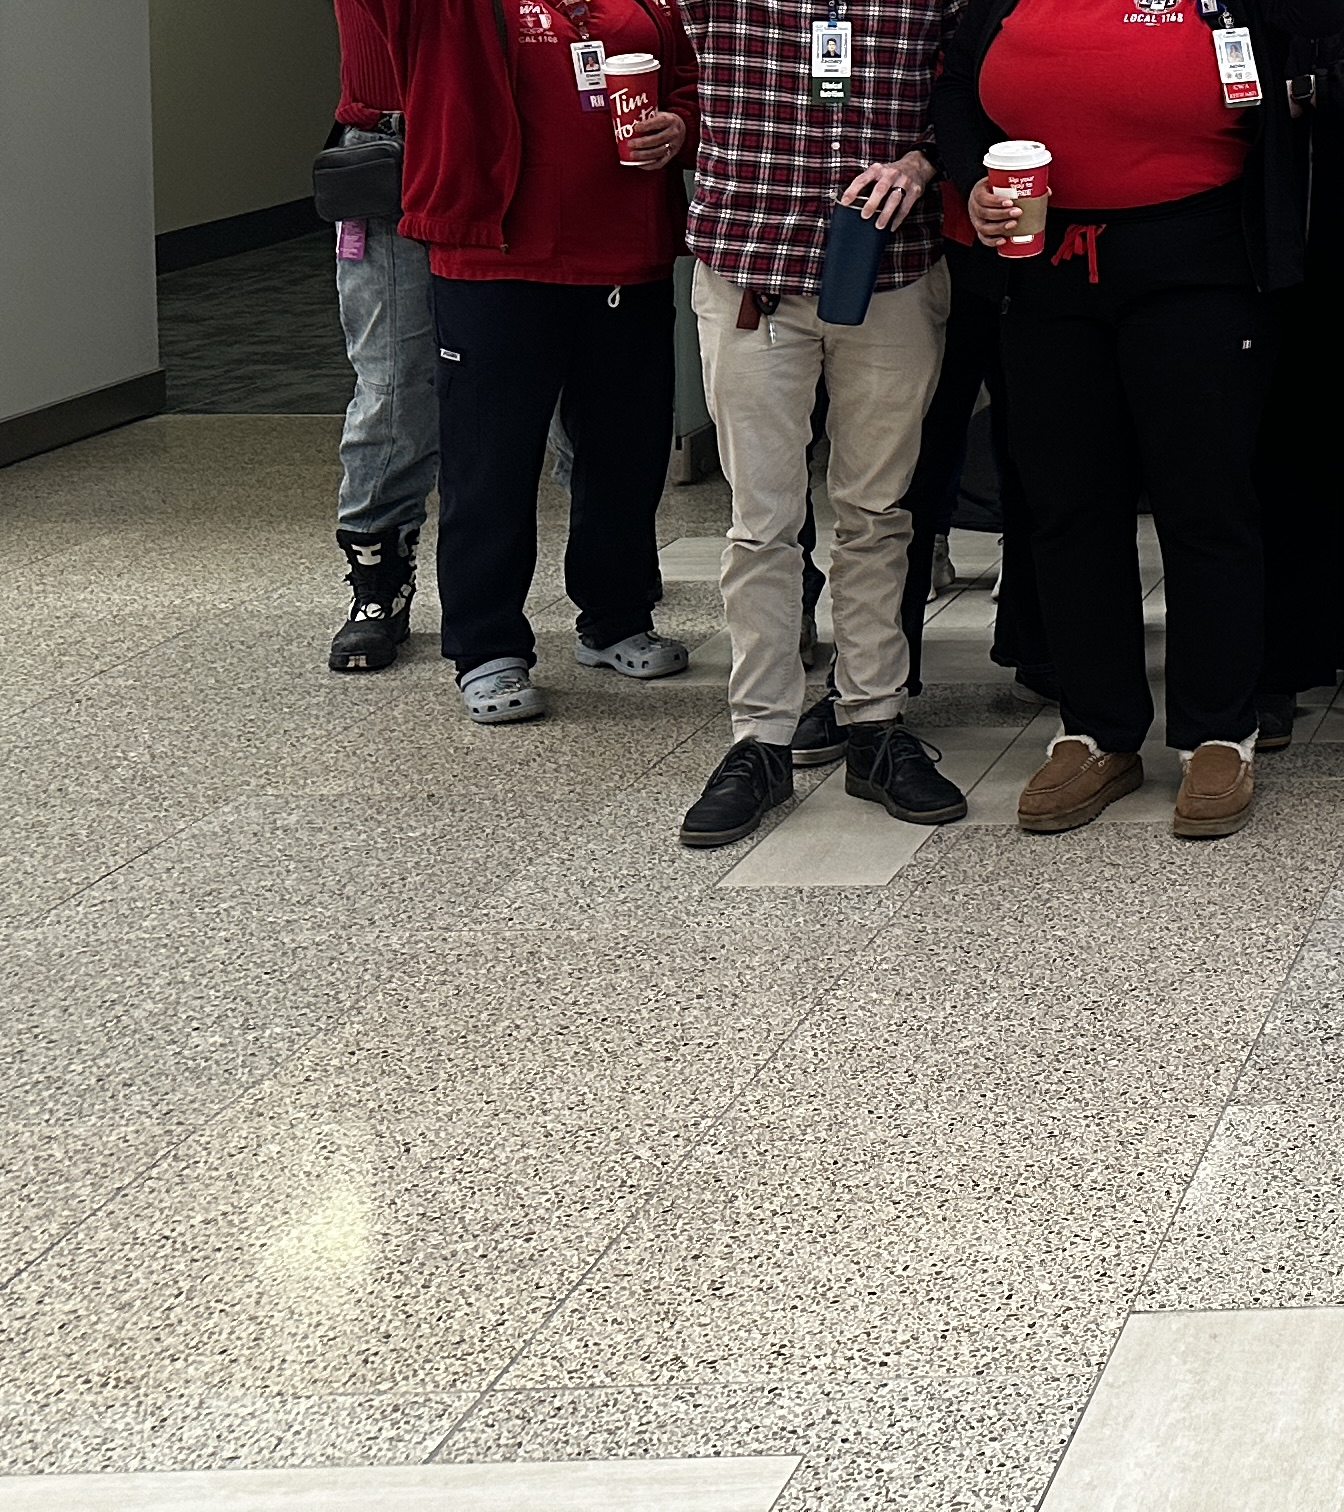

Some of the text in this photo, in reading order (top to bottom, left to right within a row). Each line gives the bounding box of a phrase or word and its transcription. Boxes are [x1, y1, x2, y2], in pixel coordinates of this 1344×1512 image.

[519, 4, 541, 15] WA
[1123, 12, 1184, 24] LOCAL 1168
[518, 35, 538, 43] CAL
[609, 87, 649, 116] Tim
[612, 105, 658, 145] Hoto
